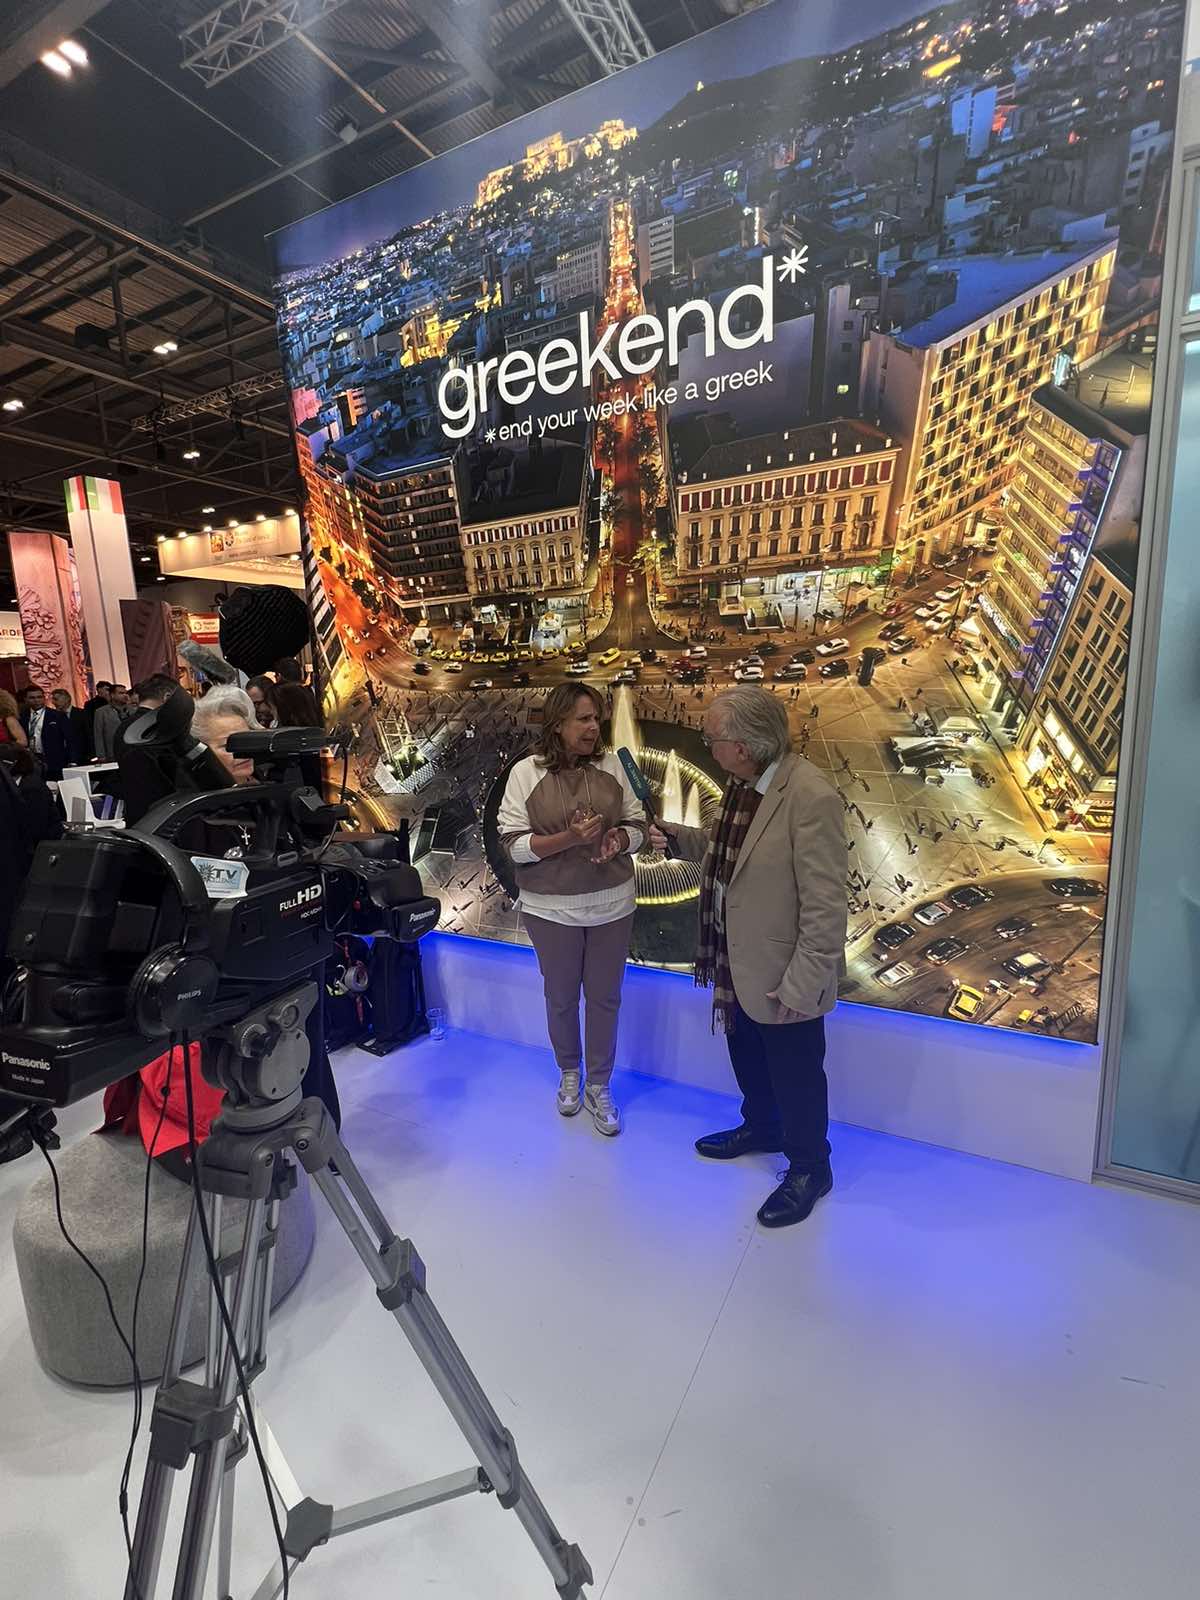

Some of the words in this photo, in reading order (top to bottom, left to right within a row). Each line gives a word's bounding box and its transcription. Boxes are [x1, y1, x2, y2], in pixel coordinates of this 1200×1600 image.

[537, 406, 578, 438] your
[583, 392, 638, 421] week
[643, 384, 678, 409] like
[684, 382, 699, 400] a
[705, 360, 774, 401] greek
[279, 898, 298, 912] FULL
[297, 884, 322, 905] HD
[408, 908, 437, 923] Panasonic
[177, 989, 202, 1001] PHILIPS
[1, 1051, 51, 1071] Panasonic
